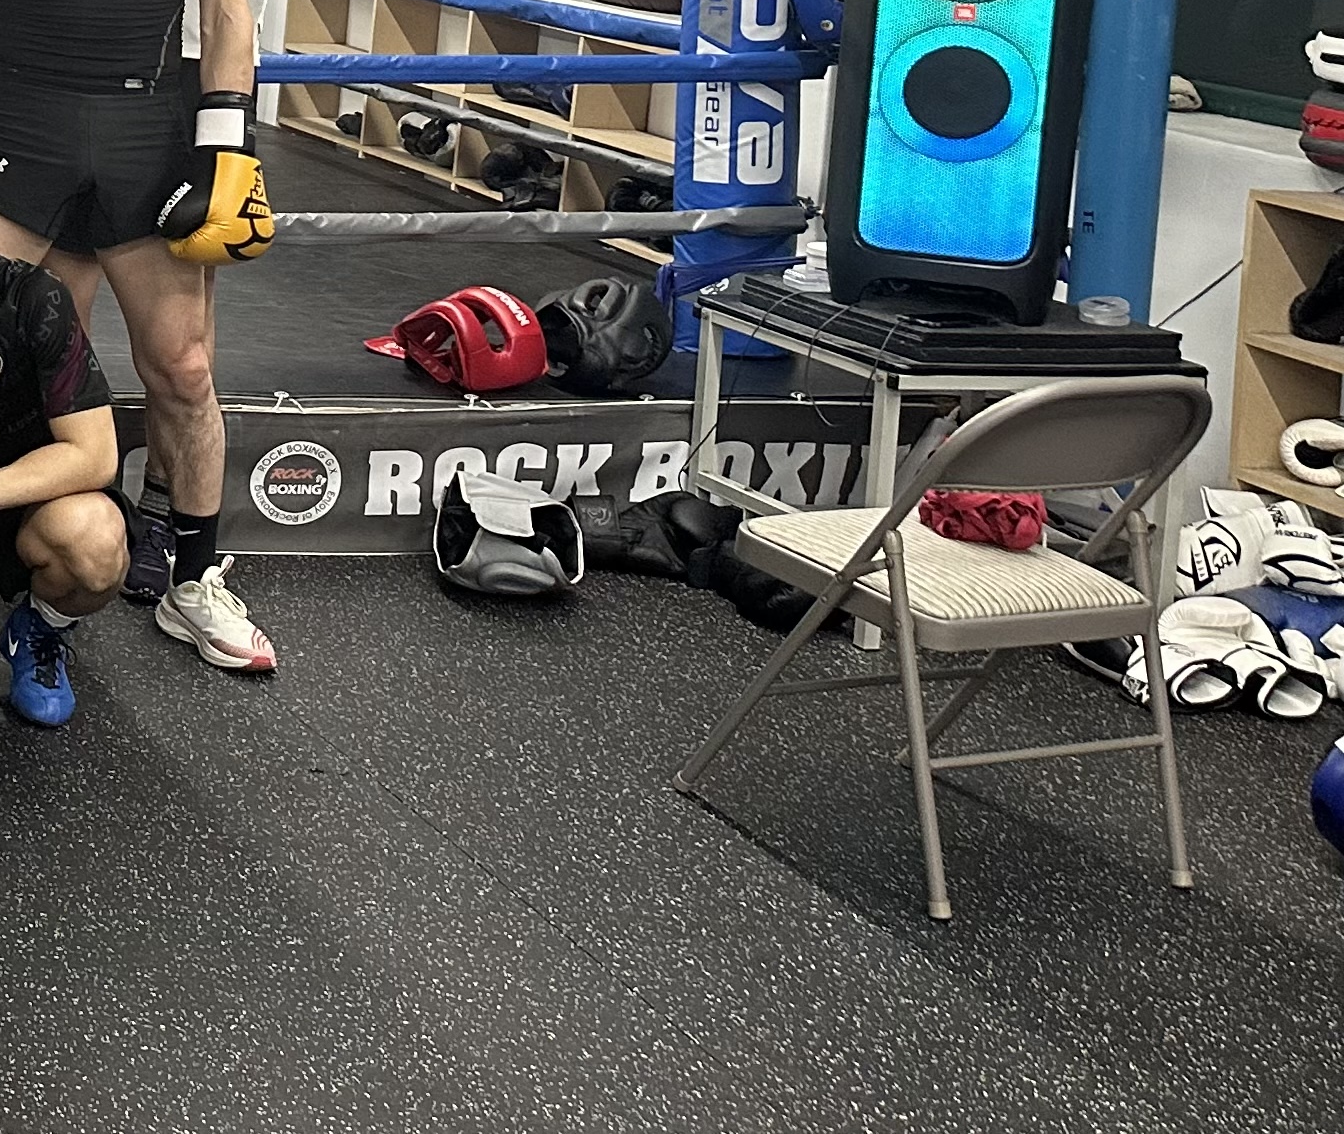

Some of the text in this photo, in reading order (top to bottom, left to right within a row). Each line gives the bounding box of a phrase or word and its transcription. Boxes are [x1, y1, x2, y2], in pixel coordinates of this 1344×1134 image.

[257, 448, 285, 472] ROCK
[286, 443, 328, 460] BOXING
[269, 467, 318, 480] ROCK
[364, 442, 613, 516] ROCK
[267, 484, 323, 495] BOXING
